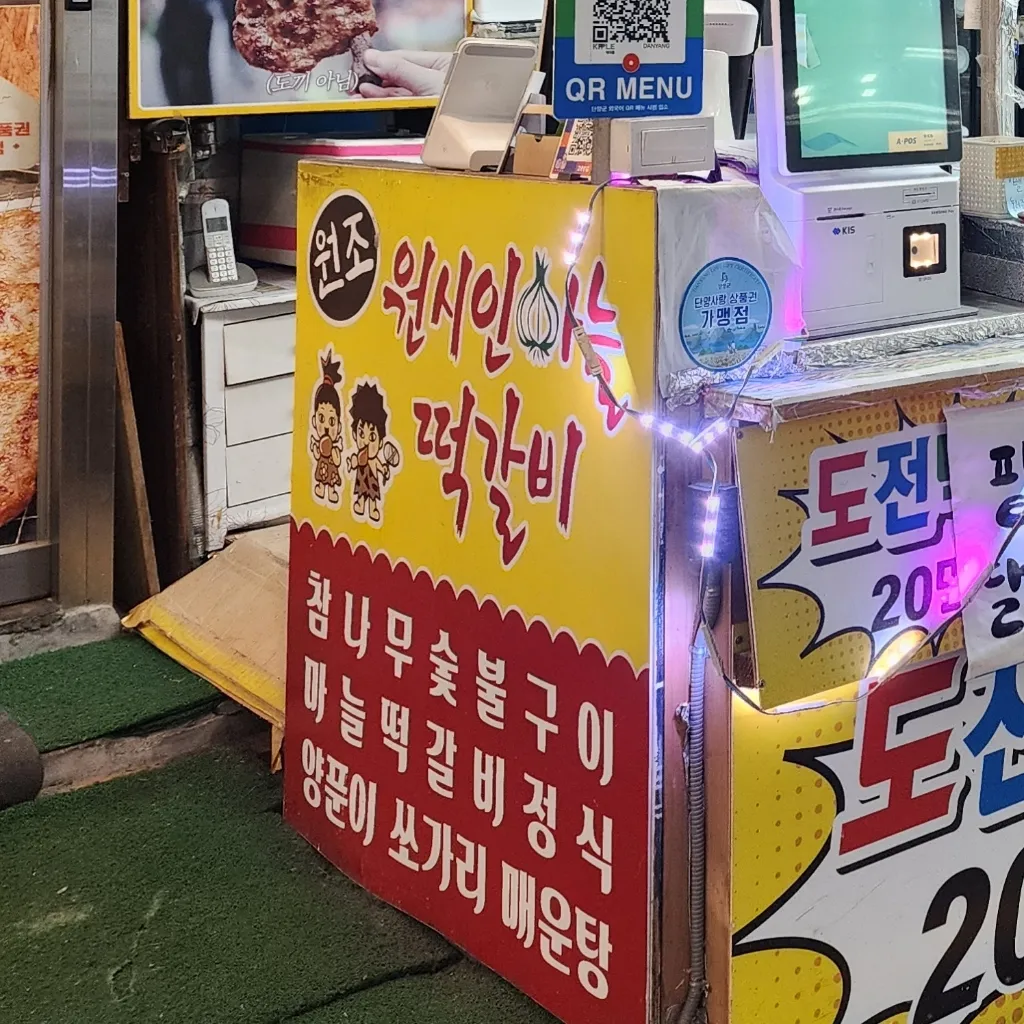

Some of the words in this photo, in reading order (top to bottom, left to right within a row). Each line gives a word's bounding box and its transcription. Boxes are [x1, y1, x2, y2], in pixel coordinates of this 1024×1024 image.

[315, 69, 360, 93] 아님)
[566, 77, 606, 102] QR
[616, 76, 692, 100] MENU
[842, 226, 856, 235] KIS
[312, 210, 374, 301] 원조
[694, 294, 726, 309] 단양사랑
[729, 291, 757, 304] 상품권
[702, 305, 749, 329] 가맹점
[411, 383, 584, 568] 떡갈비
[811, 434, 953, 548] 도전
[301, 737, 377, 848] 양푼이
[388, 797, 487, 915] 쏘가리
[501, 859, 612, 1000] 매운탕
